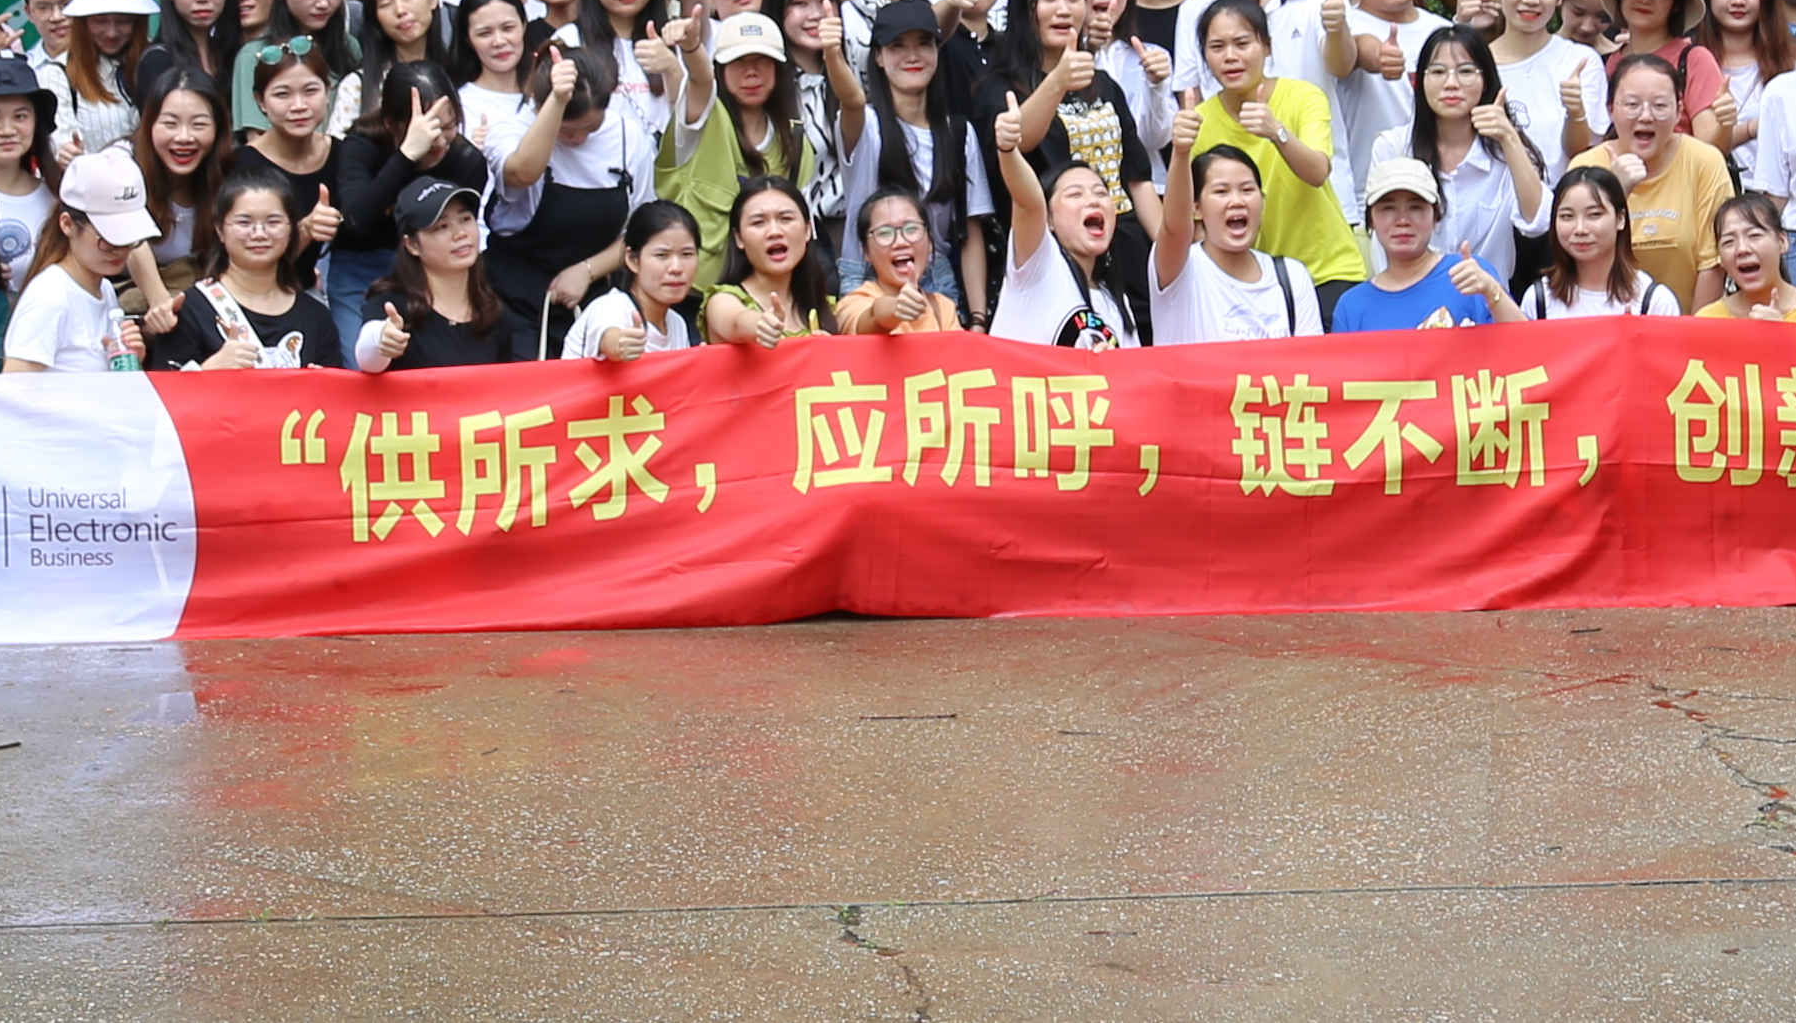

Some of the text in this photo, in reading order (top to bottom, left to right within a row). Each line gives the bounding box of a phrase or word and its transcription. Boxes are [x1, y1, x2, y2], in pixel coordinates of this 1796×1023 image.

[28, 487, 126, 509] Universal
[29, 513, 178, 542] Electronic
[31, 547, 114, 566] Business
